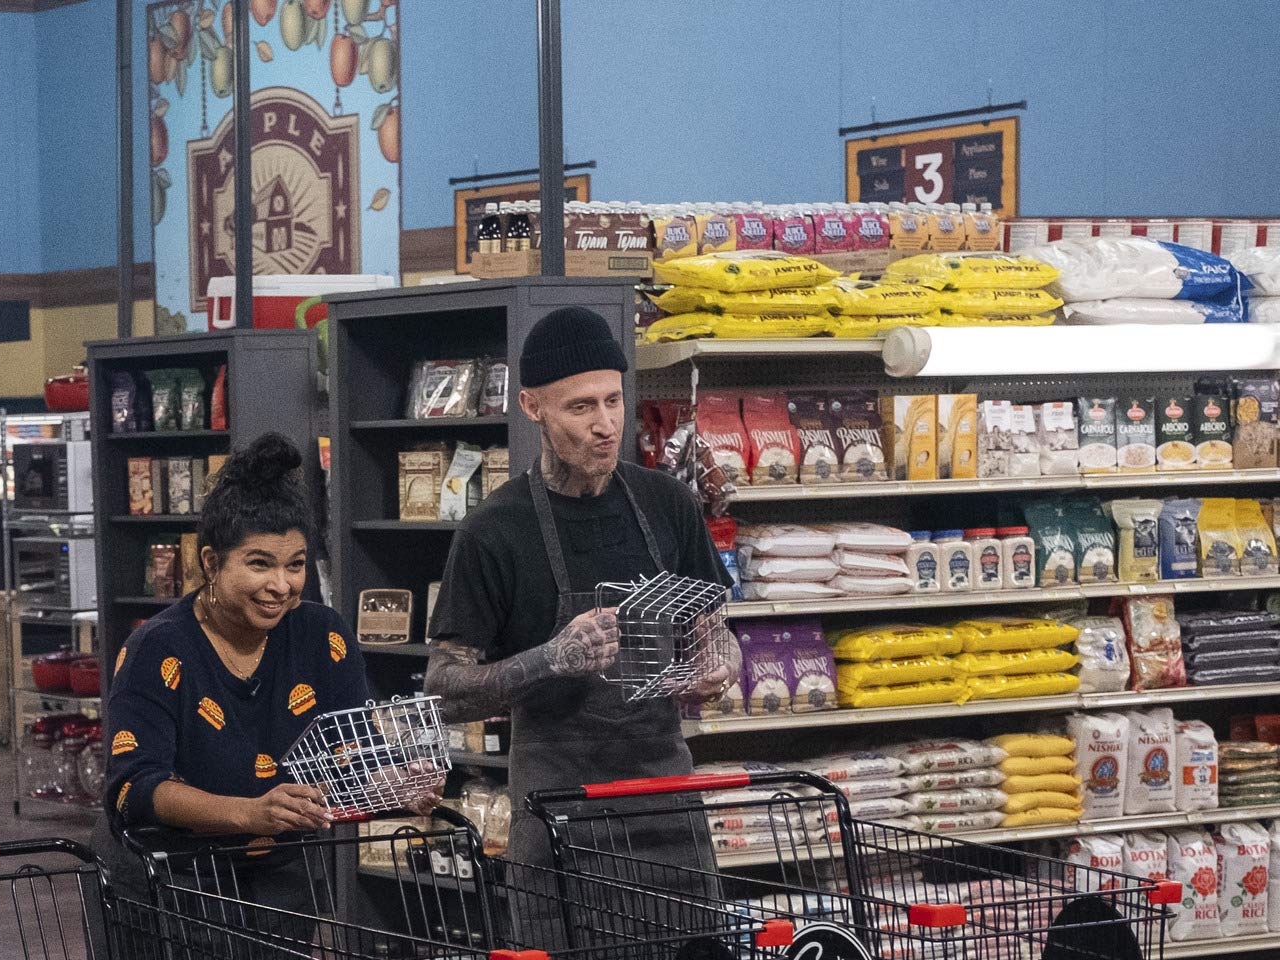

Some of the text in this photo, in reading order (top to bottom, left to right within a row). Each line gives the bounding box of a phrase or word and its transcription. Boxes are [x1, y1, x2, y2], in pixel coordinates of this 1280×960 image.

[217, 111, 326, 175] APLE
[914, 152, 944, 204] 3
[1090, 855, 1120, 868] BOTA
